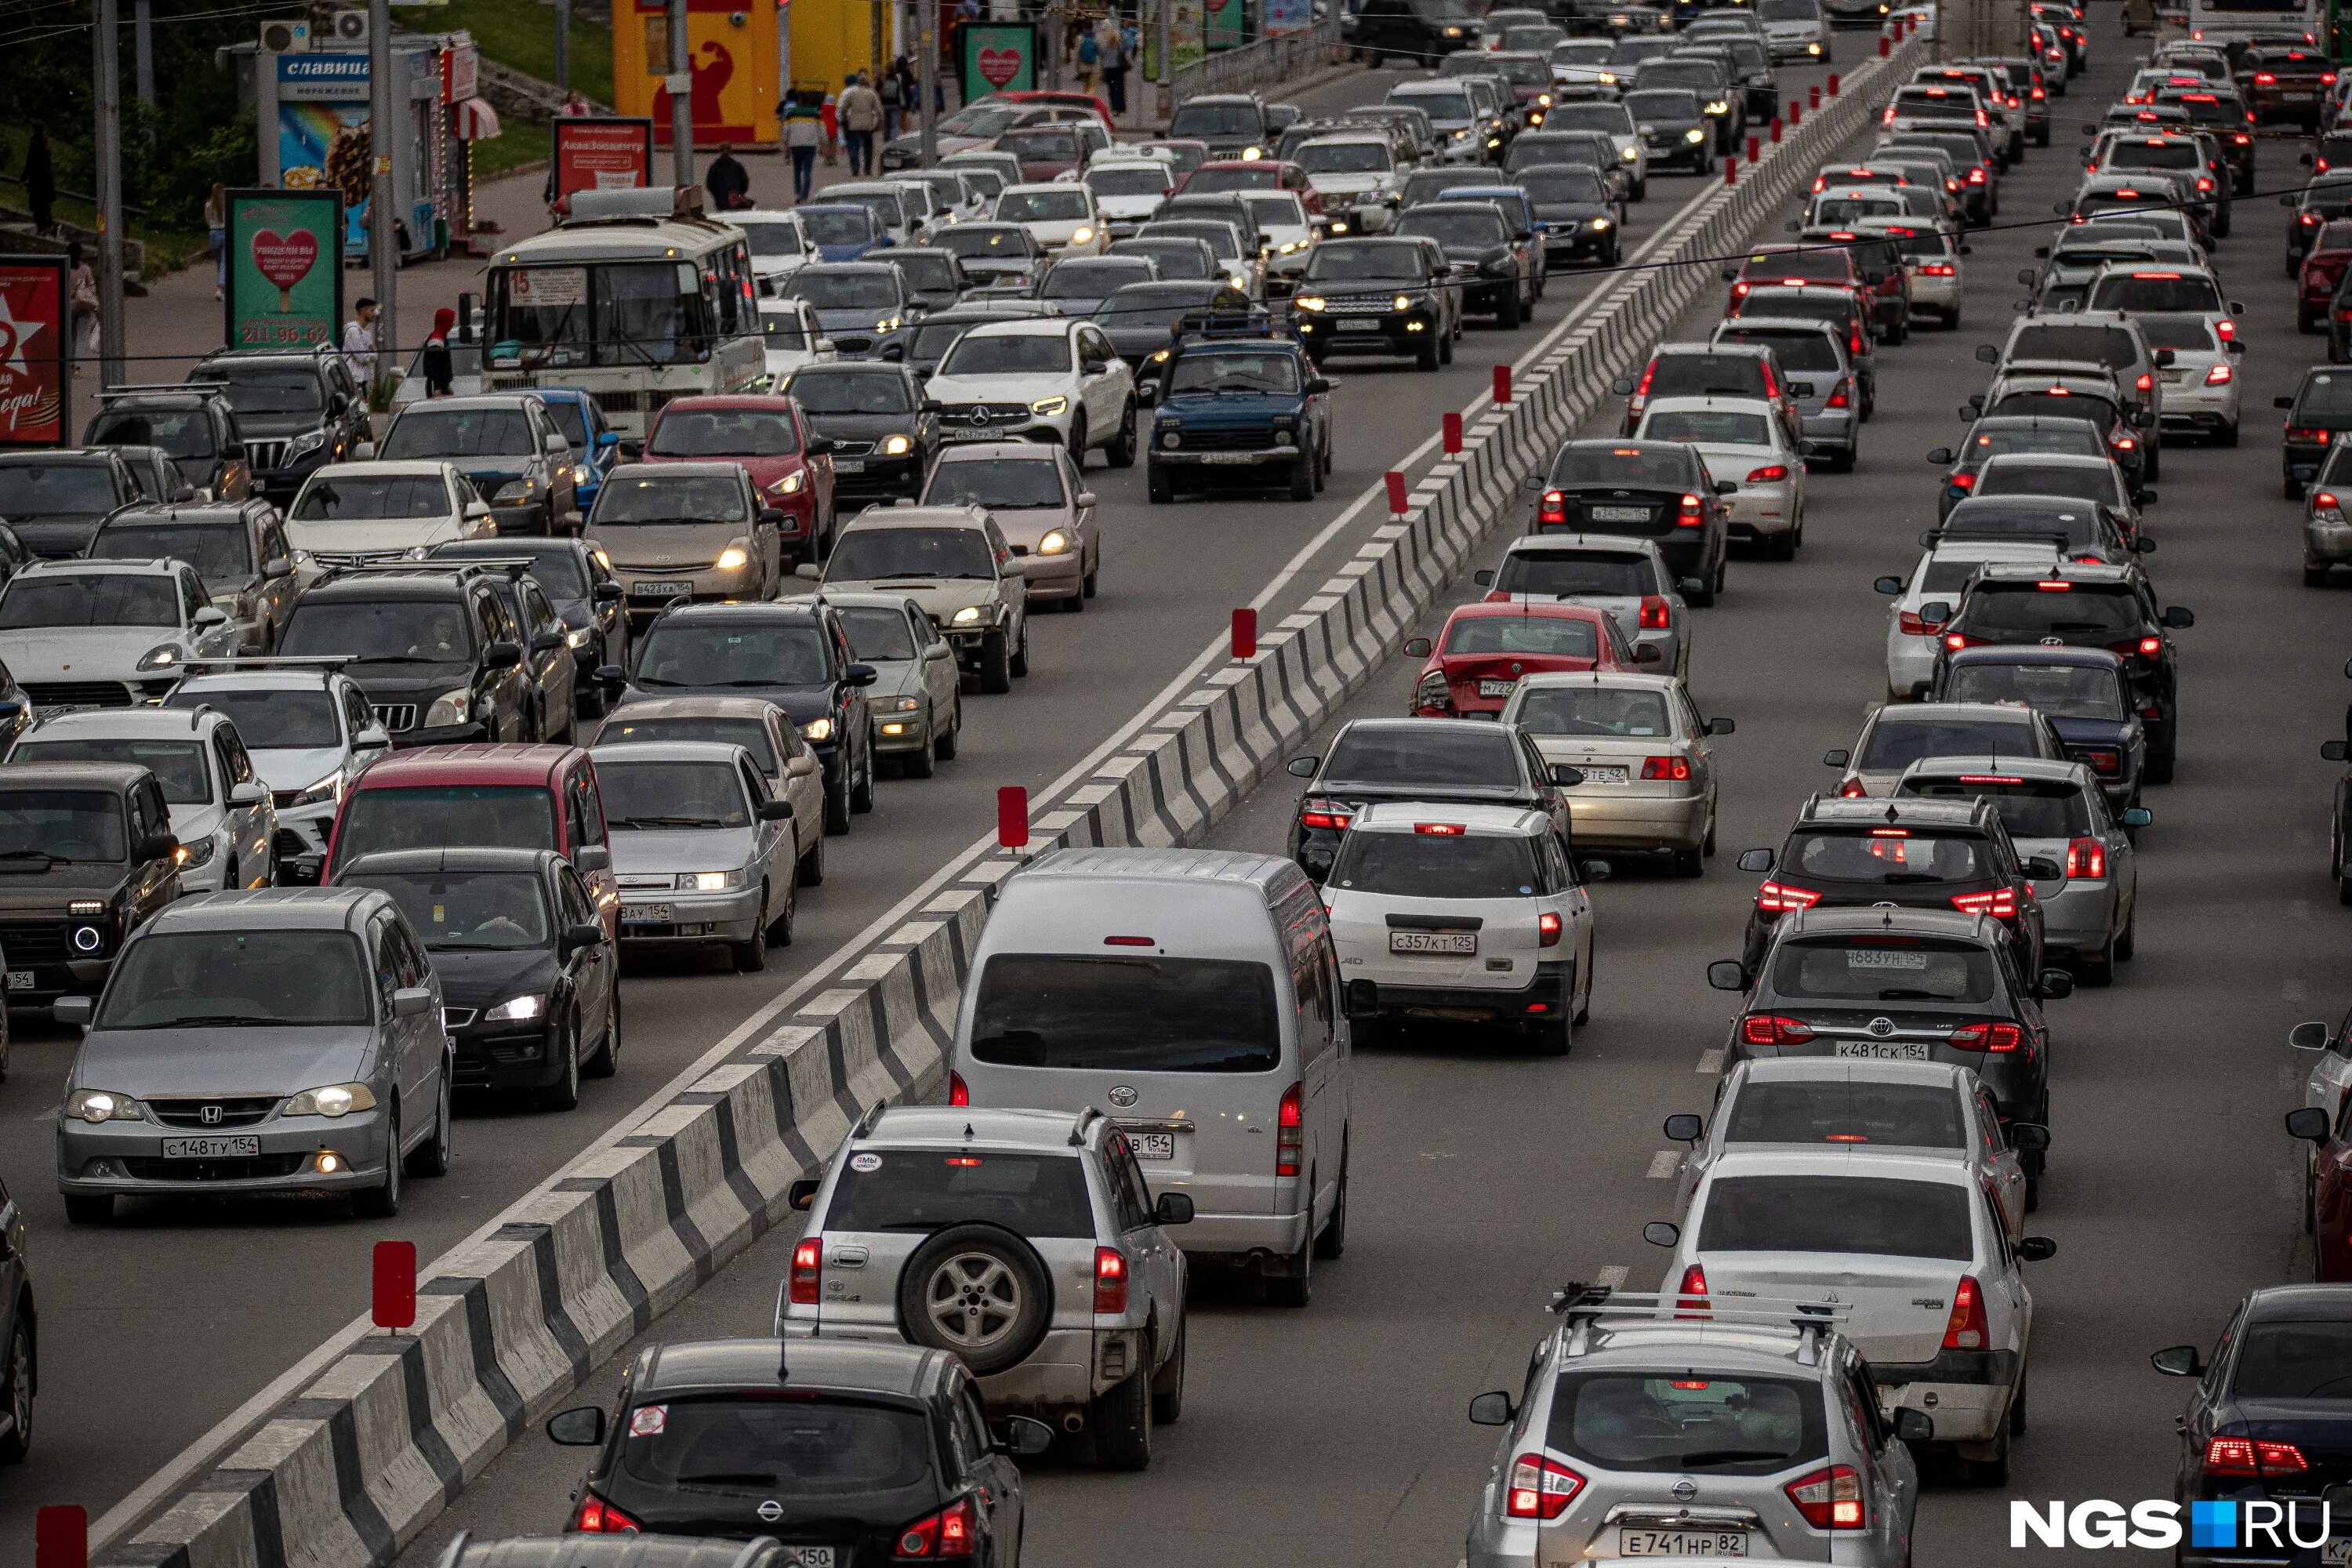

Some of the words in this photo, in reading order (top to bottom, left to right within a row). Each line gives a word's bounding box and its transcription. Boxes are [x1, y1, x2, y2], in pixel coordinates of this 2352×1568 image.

[510, 269, 530, 293] 15
[241, 326, 328, 343] 211-96-62
[1609, 769, 1621, 778] 42
[648, 906, 667, 916] 154
[1396, 935, 1448, 949] С357КТ
[1452, 936, 1471, 947] 125
[1840, 1044, 1899, 1059] К481СК
[1902, 1045, 1924, 1057] 154
[168, 1140, 229, 1156] С148ТУ
[232, 1138, 256, 1150] 154
[1144, 1134, 1169, 1149] 154
[1629, 1533, 1711, 1555] Е741НР
[1718, 1535, 1738, 1551] 82
[799, 1549, 828, 1565] 150
